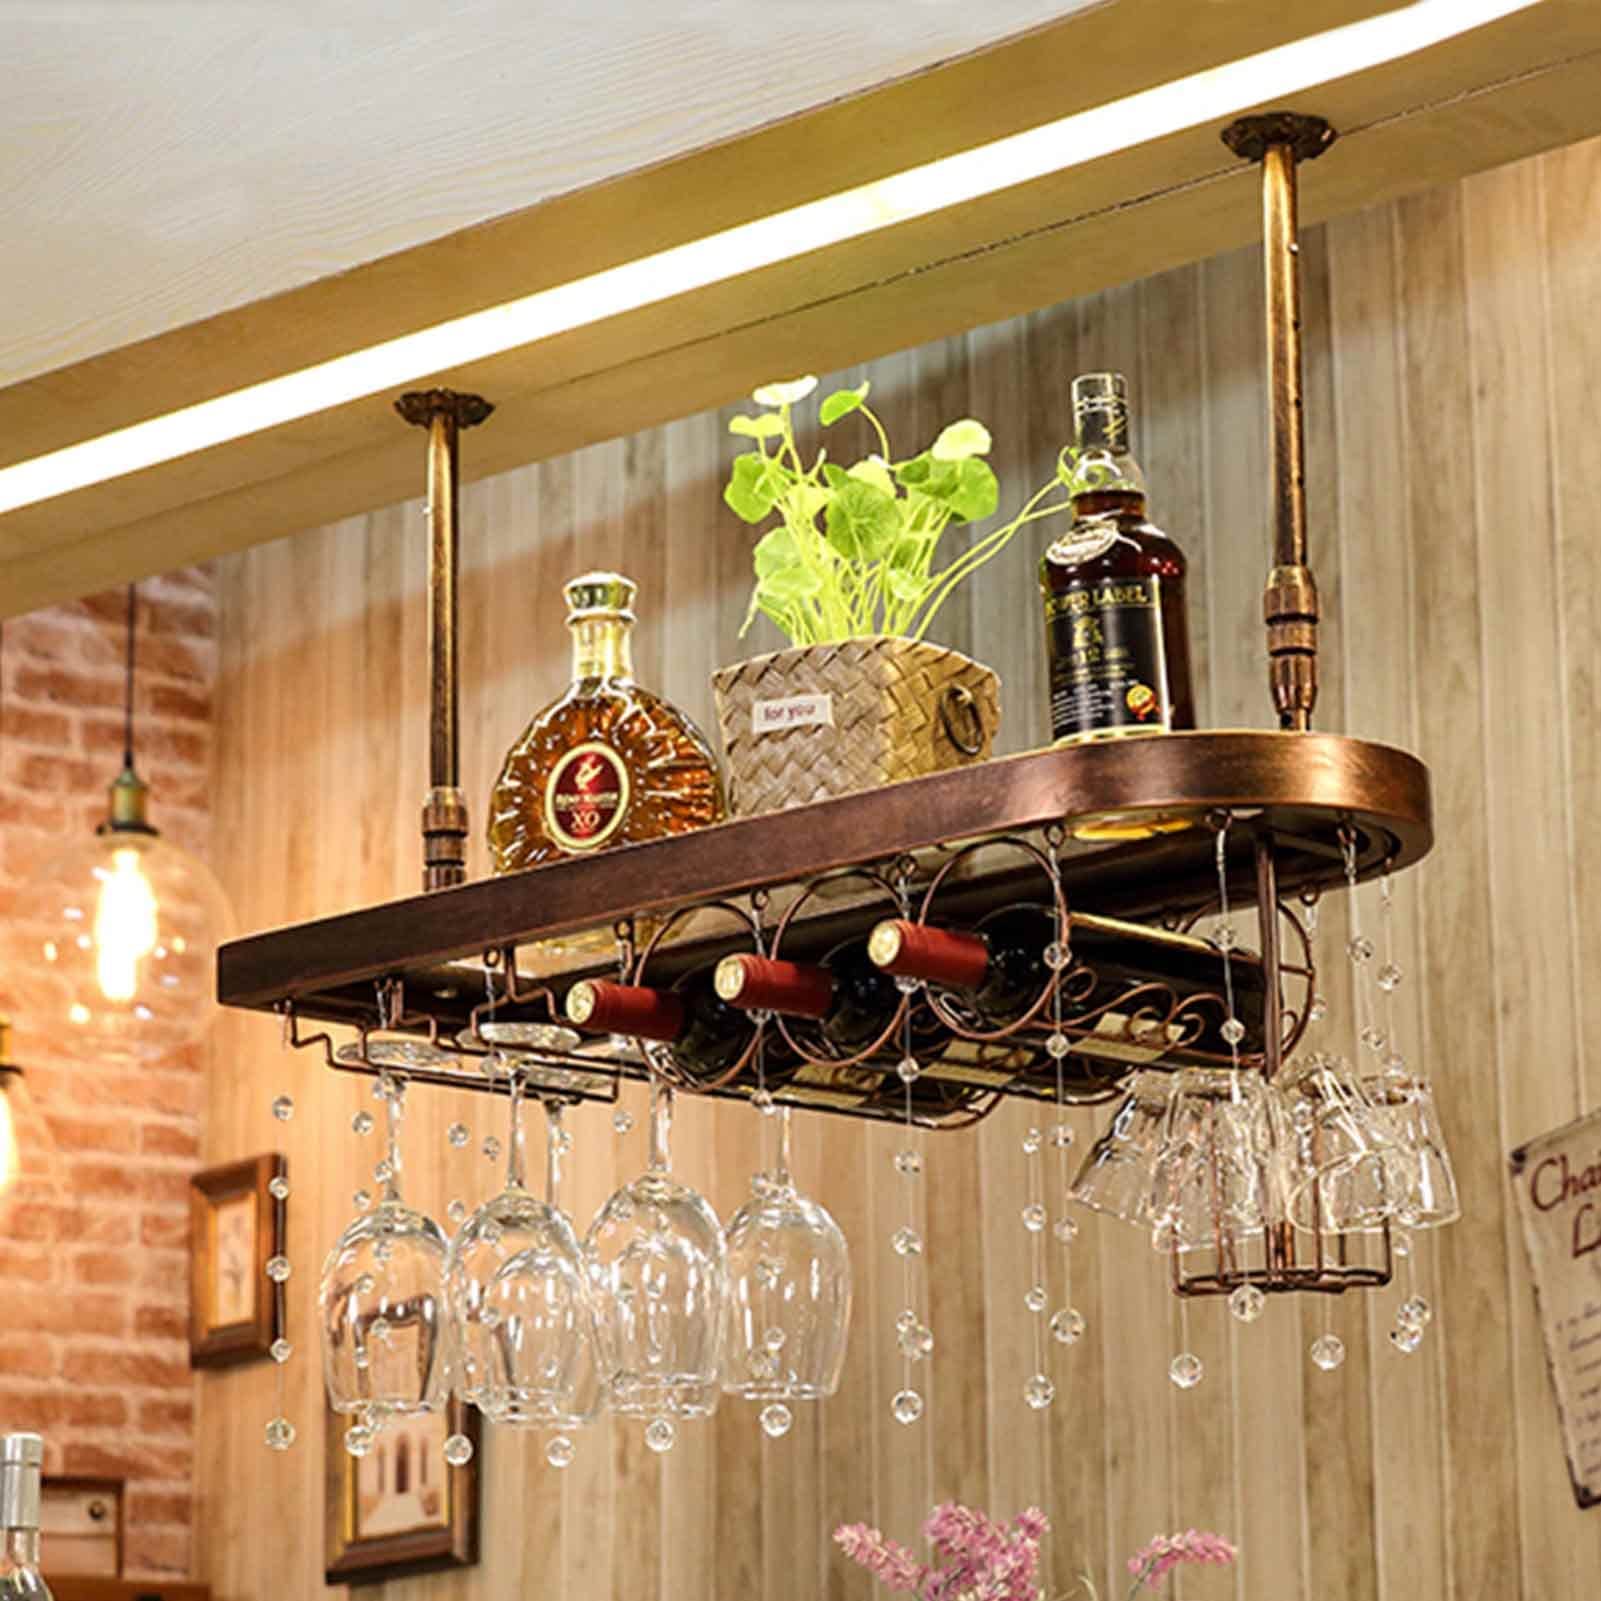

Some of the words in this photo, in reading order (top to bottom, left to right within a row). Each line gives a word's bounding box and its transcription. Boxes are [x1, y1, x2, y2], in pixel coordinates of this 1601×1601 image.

[1093, 586, 1148, 605] LABEL
[764, 705, 784, 720] for
[787, 703, 817, 720] you
[570, 808, 600, 832] XO
[1531, 1154, 1601, 1212] Cha
